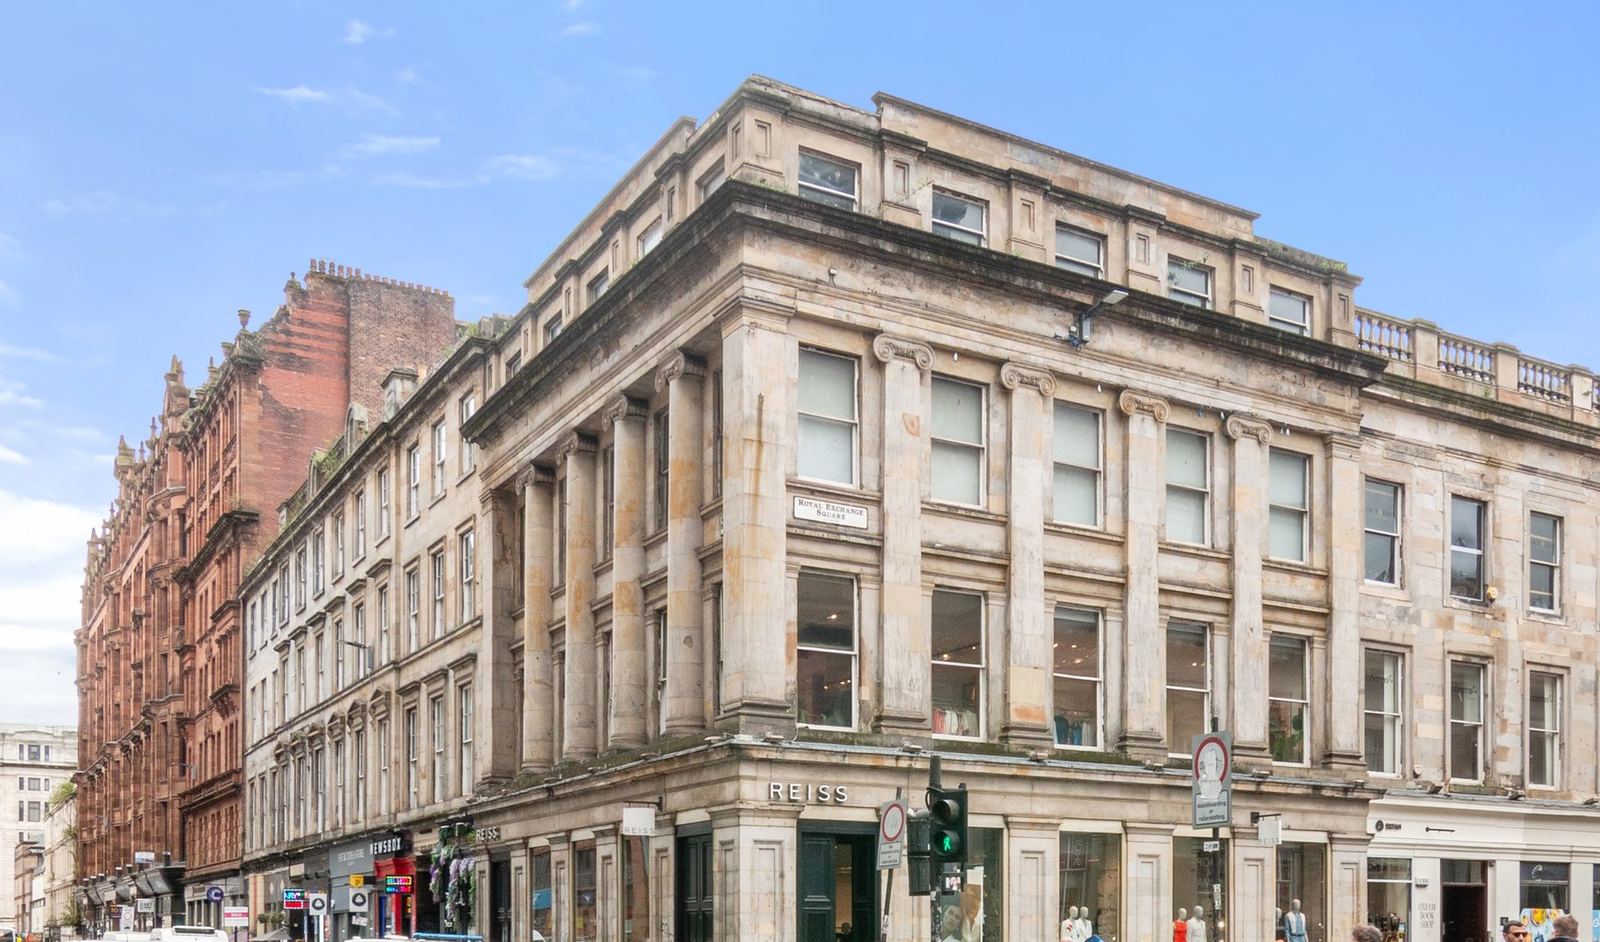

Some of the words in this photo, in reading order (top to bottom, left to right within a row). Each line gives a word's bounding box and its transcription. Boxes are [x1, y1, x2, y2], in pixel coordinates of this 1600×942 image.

[798, 499, 823, 509] ROYAL
[826, 504, 864, 516] EXCHANGE
[816, 510, 846, 520] SQUARE
[769, 782, 848, 802] REISS
[476, 826, 498, 840] REISS
[624, 826, 656, 834] REISS
[369, 837, 401, 855] NEWSBOX
